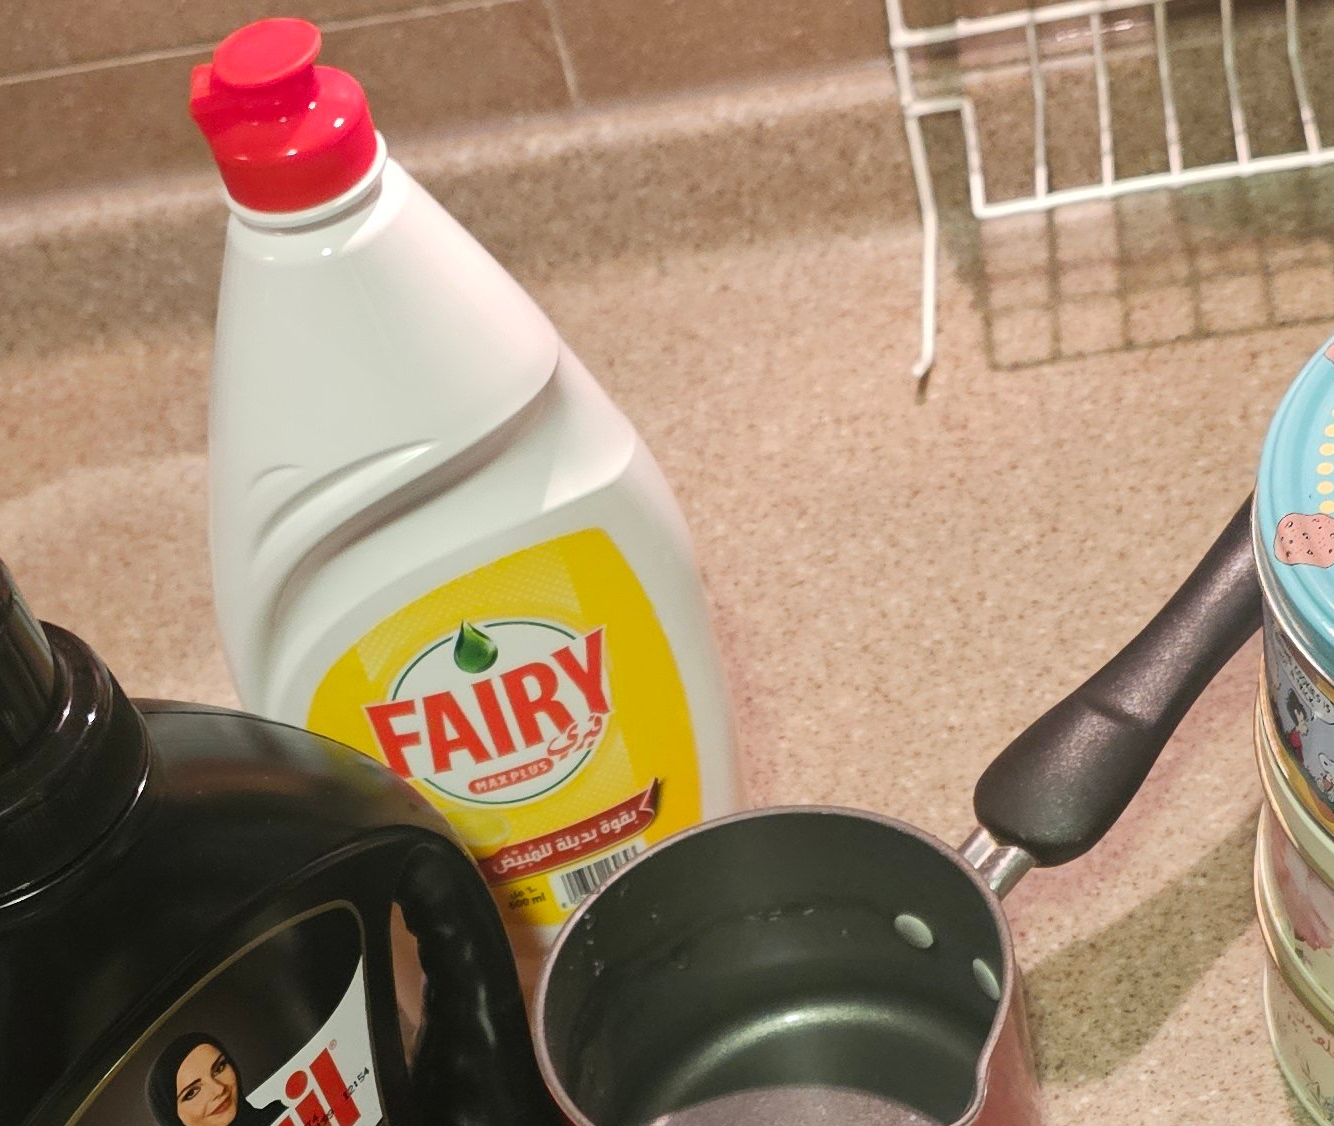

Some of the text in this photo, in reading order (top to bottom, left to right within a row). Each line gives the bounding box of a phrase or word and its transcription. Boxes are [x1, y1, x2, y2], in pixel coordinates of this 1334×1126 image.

[364, 627, 612, 779] FAIRY
[547, 714, 603, 762] فيري
[475, 760, 549, 792] MAX PLUS
[599, 809, 639, 835] بقوة
[555, 828, 598, 852] بديلة
[531, 893, 546, 904] ml
